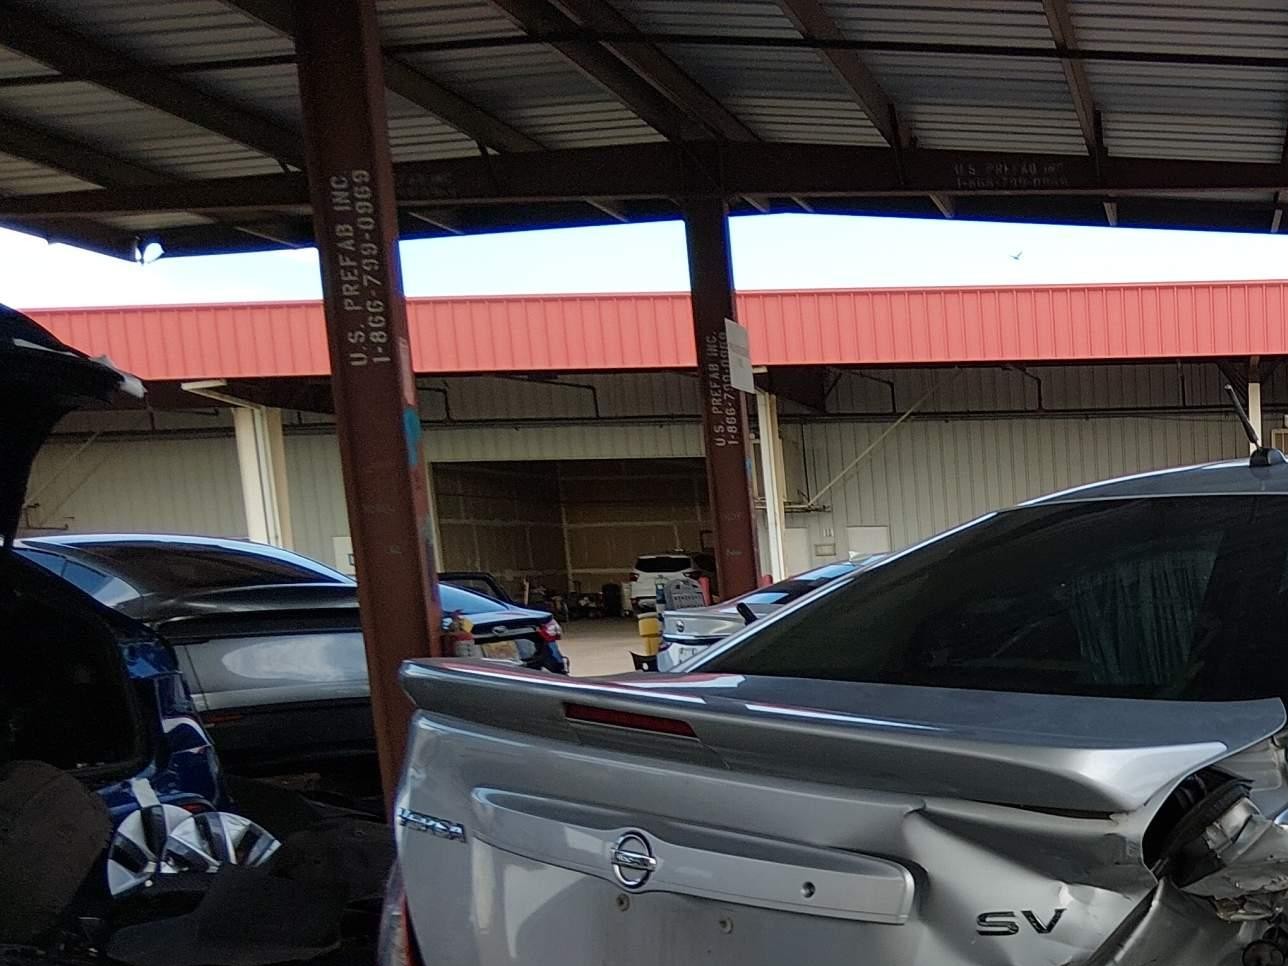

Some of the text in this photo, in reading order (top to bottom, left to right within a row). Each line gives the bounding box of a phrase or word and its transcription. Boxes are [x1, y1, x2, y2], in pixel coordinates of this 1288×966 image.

[336, 222, 363, 311] PREFAB
[352, 169, 391, 364] 1-866-799-0969
[348, 323, 368, 366] U.S.
[708, 363, 723, 415] PREFAB
[976, 908, 1067, 936] SV
